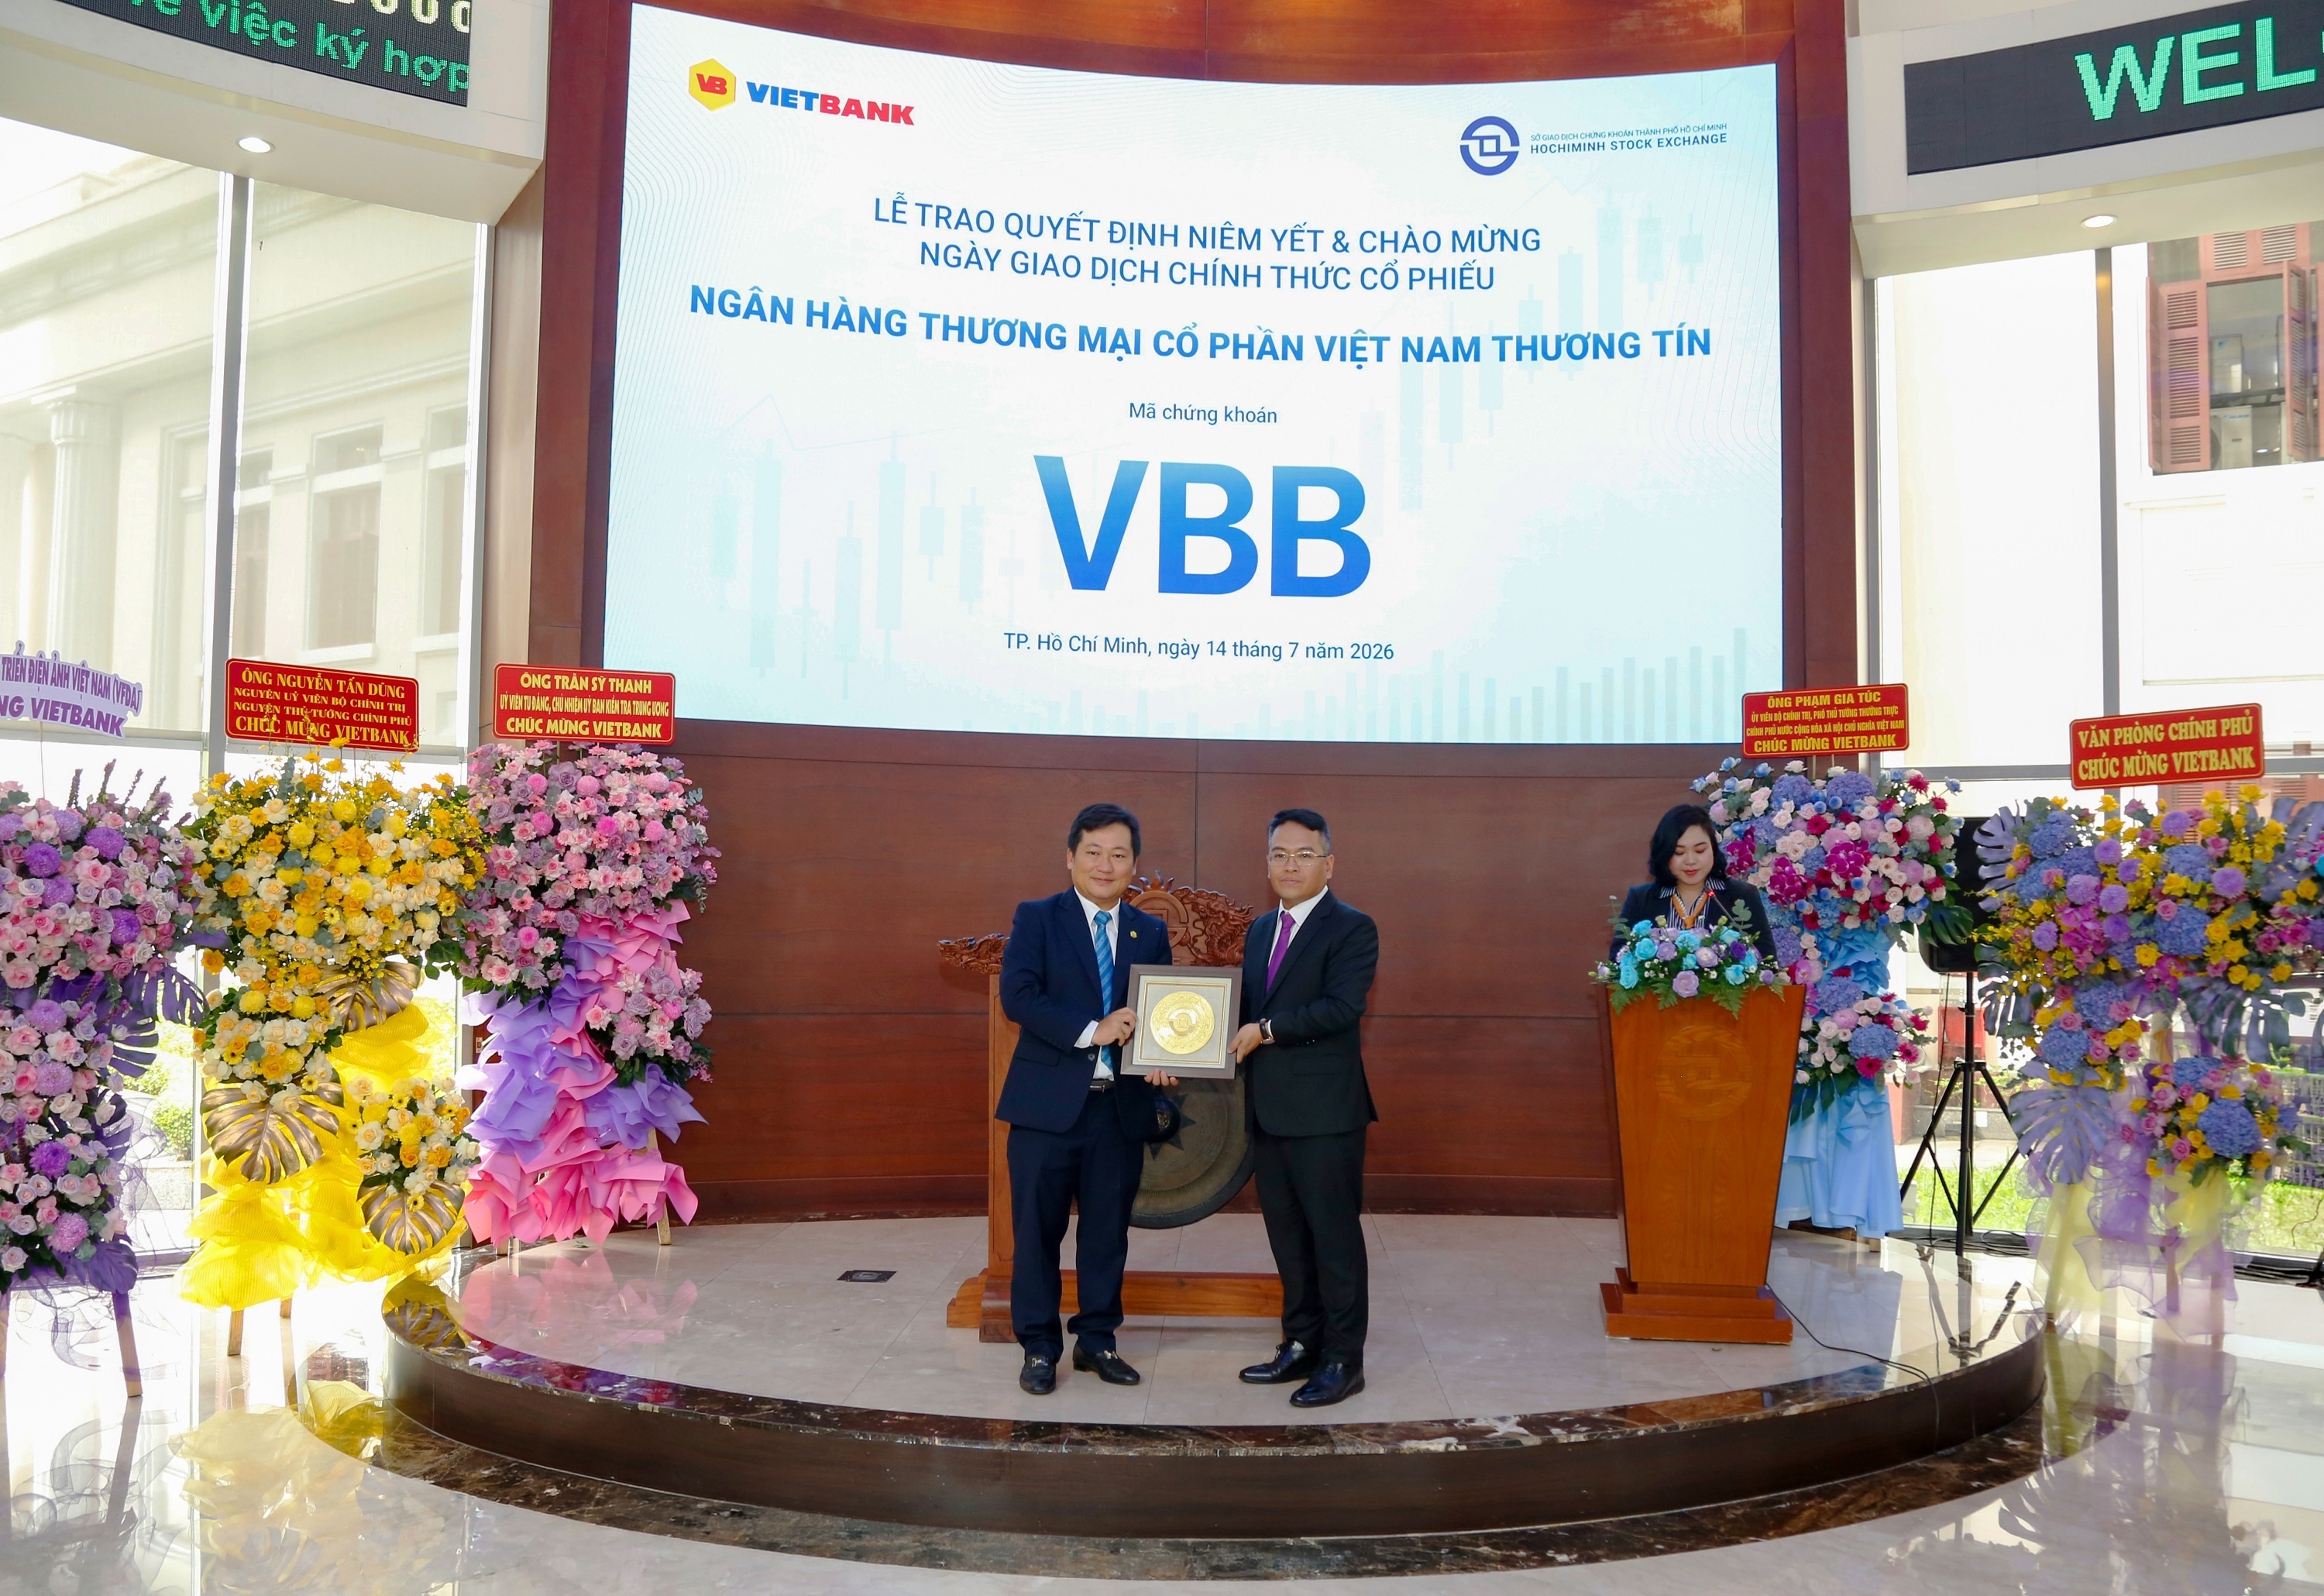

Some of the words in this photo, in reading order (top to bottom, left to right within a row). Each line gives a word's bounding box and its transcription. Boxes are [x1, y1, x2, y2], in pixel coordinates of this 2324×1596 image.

[315, 22, 369, 69] ký
[383, 39, 469, 92] hợp
[2075, 17, 2324, 121] WEL
[696, 73, 727, 95] VB
[746, 81, 914, 126] VIETBANK
[1531, 132, 1540, 141] SỞ
[1561, 133, 1578, 142] DỊCH
[1580, 131, 1606, 139] CHỨNG
[1608, 129, 1634, 138] KHOÁN
[1635, 127, 1661, 136] THÀNH
[1663, 125, 1679, 134] PHỐ
[1680, 124, 1691, 133] HỒ
[1693, 123, 1705, 132] CHÍ
[1707, 122, 1727, 131] MINH
[1531, 142, 1605, 154] HOCHIMINH
[1611, 139, 1652, 150] STOCK
[1657, 132, 1727, 148] EXCHANGE
[875, 192, 908, 225] LỄ
[915, 202, 995, 233] TRAO
[1005, 211, 1100, 242] QUYẾT
[1108, 221, 1178, 250] ĐỊNH
[1189, 221, 1261, 250] NIÊM
[1270, 222, 1324, 253] YẾT
[1332, 231, 1350, 253] &
[1360, 225, 1441, 253] CHÀO
[1452, 224, 1541, 253] MỪNG
[920, 240, 1002, 272] NGÀY
[1011, 250, 1081, 278] GIAO
[1092, 256, 1159, 287] DỊCH
[1169, 258, 1261, 287] CHÍNH
[1270, 261, 1351, 290] THỨC
[1360, 259, 1399, 290] CỔ
[1409, 260, 1494, 291] PHIẾU
[690, 284, 794, 325] NGÂN
[806, 296, 907, 337] HÀNG
[918, 311, 1067, 350] THƯƠNG
[1078, 325, 1141, 362] MẠI
[1153, 322, 1199, 357] CỔ
[1209, 325, 1304, 361] PHẦN
[1315, 328, 1391, 370] VIỆT
[1401, 335, 1480, 363] NAM
[1492, 332, 1641, 362] THƯƠNG
[1652, 322, 1710, 357] TÍN
[1129, 402, 1157, 419] Mã
[1162, 404, 1218, 425] chứng
[1224, 405, 1277, 423] khoán
[1033, 455, 1371, 597] VBB
[1004, 632, 1030, 650] TP.
[1037, 631, 1062, 652] Hồ
[1068, 634, 1097, 653] Chí
[1104, 636, 1152, 658] Minh,
[1158, 639, 1200, 660] ngày
[1207, 641, 1227, 657] 14
[1232, 640, 1282, 662] tháng
[1288, 642, 1299, 659] 7
[1305, 642, 1344, 659] năm
[1350, 643, 1394, 659] 2026
[2, 643, 27, 683] TRIỂN
[28, 653, 50, 692] ĐIỆN
[50, 653, 70, 689] ẢNH
[72, 662, 90, 700] VIỆT
[91, 672, 111, 700] NAM
[242, 667, 273, 685] ÔNG
[277, 672, 332, 691] NGUYỄN
[336, 676, 364, 694] TẤN
[368, 682, 405, 699] DŨNG
[520, 672, 551, 690] ÔNG
[554, 672, 589, 691] TRẦN
[591, 675, 607, 692] SỸ
[608, 677, 651, 694] THANH
[234, 687, 280, 700] NGUYÊN
[284, 690, 299, 702] UỶ
[302, 693, 328, 704] VIÊN
[332, 697, 346, 707] BỘ
[350, 699, 384, 710] CHÍNH
[387, 703, 405, 714] TRỊ
[500, 690, 508, 710] UỶ
[509, 693, 523, 710] VIÊN
[531, 692, 551, 715] ĐẢNG,
[552, 693, 563, 712] CHỦ
[564, 695, 583, 714] NHIỆM
[583, 694, 591, 714] UỶ
[592, 698, 605, 714] BAN
[606, 694, 620, 714] KIỂM
[621, 700, 631, 715] TRA
[632, 700, 651, 717] TRUNG
[1767, 696, 1792, 708] ÔNG
[1795, 695, 1831, 708] PHẠM
[1834, 693, 1855, 705] GIA
[1857, 690, 1881, 703] TÚC
[31, 697, 125, 737] VIETBANK
[234, 702, 280, 714] NGUYÊN
[311, 708, 349, 721] TƯỚNG
[352, 713, 387, 724] CHÍNH
[390, 715, 411, 726] PHỦ
[506, 716, 543, 734] CHÚC
[546, 717, 589, 735] MỪNG
[593, 721, 662, 738] VIETBANK
[1746, 725, 1764, 737] CHÍNH
[1765, 724, 1776, 736] PHỦ
[1794, 724, 1810, 736] CỘNG
[1824, 722, 1832, 734] XÃ
[1833, 721, 1843, 734] HỘI
[1844, 720, 1856, 732] CHỦ
[1857, 720, 1875, 731] NGHĨA
[1876, 719, 1889, 732] VIỆT
[1890, 719, 1905, 730] NAM
[1752, 711, 1759, 723] ỦY
[1760, 711, 1772, 722] VIÊN
[1774, 710, 1782, 723] BỘ
[1783, 710, 1800, 721] CHÍNH
[1813, 708, 1825, 720] PHÓ
[1826, 707, 1838, 719] THỦ
[1883, 705, 1899, 717] TRỰC
[2078, 724, 2110, 748] VĂN
[2113, 722, 2165, 745] PHÒNG
[2168, 717, 2217, 741] CHÍNH
[2221, 708, 2254, 735] PHỦ
[335, 724, 410, 745] VIETBANK
[1754, 737, 1788, 753] CHÚC
[1791, 736, 1830, 752] MỪNG
[1833, 734, 1896, 749] VIETBANK
[2078, 752, 2119, 781] CHÚC
[2123, 749, 2168, 777] MỪNG
[2171, 746, 2256, 774] VIETBANK
